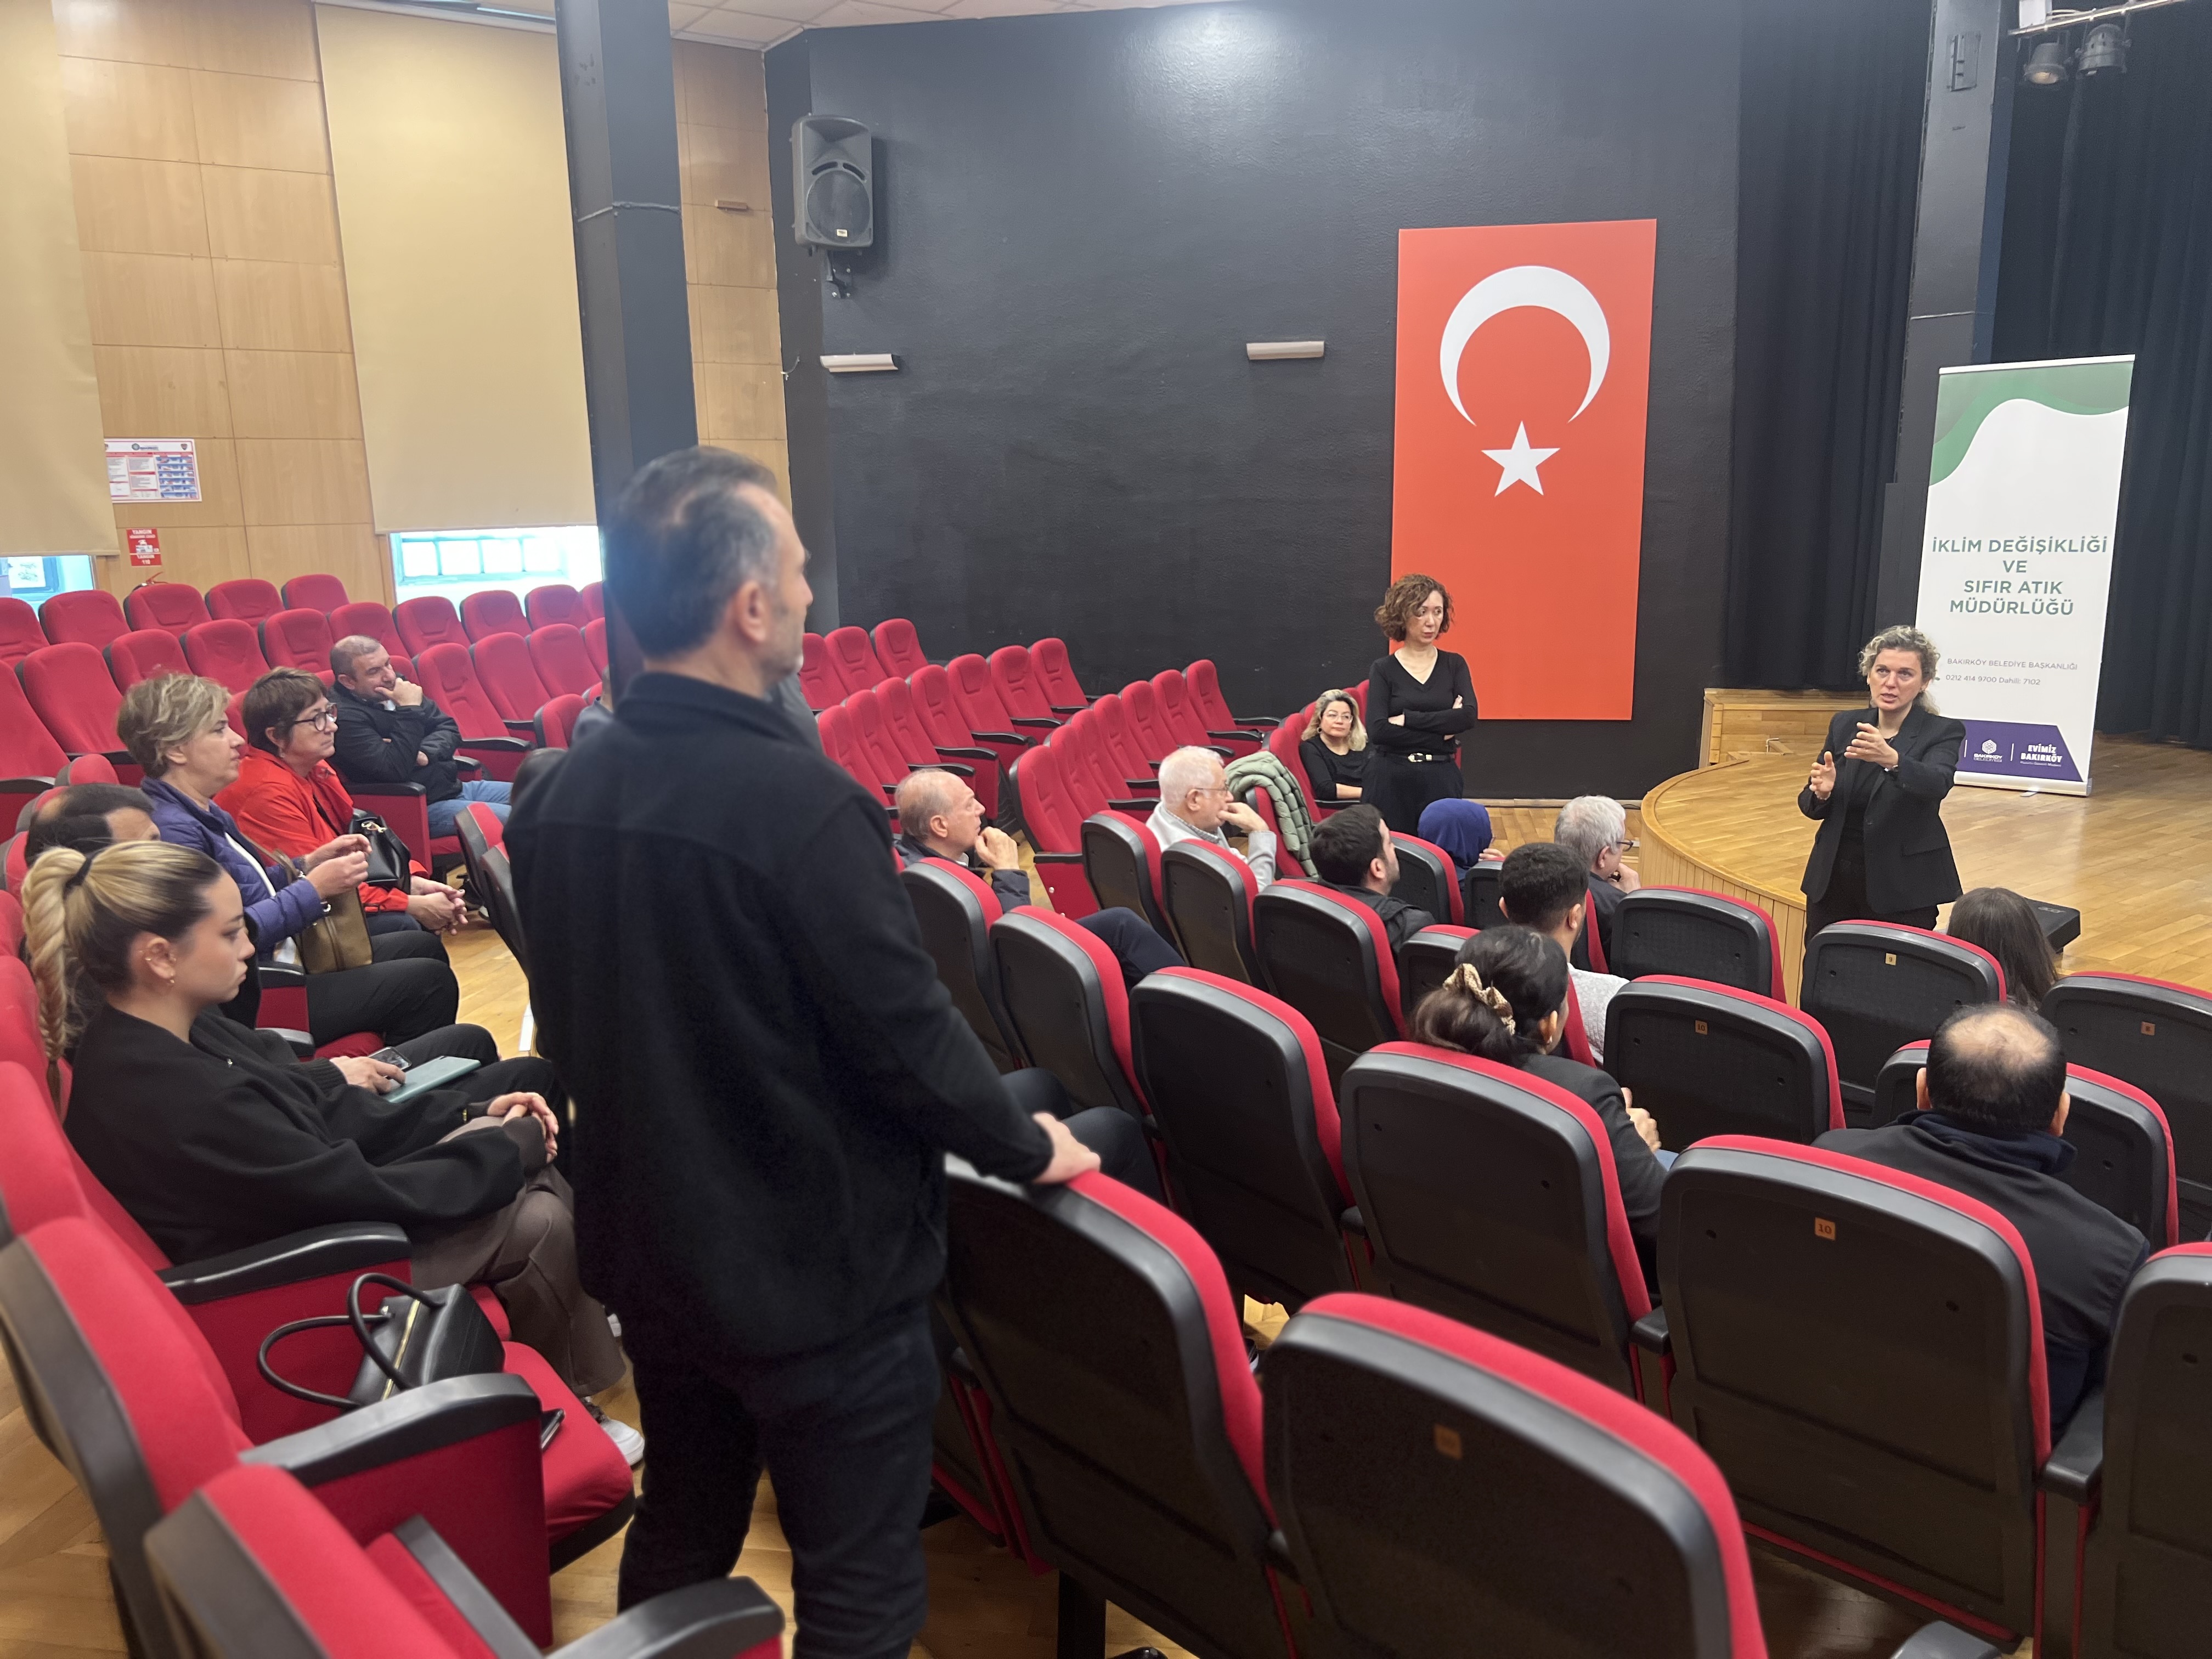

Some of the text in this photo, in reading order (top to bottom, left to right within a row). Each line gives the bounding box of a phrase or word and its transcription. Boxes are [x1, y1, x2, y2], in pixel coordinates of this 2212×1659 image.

[1932, 535, 2107, 555] İKLİM DEĞİŞİKLİĞİ
[2002, 560, 2028, 573] VE
[1964, 580, 2063, 594] SIFIR ATIK
[1950, 597, 2073, 615] MÜDÜRLÜĞÜ
[2028, 662, 2078, 670] BAŞKANLIĞI
[2028, 743, 2057, 754] EVİMİZ
[2021, 752, 2063, 763] BAKIRKÖY
[1818, 1223, 1832, 1234] 10
